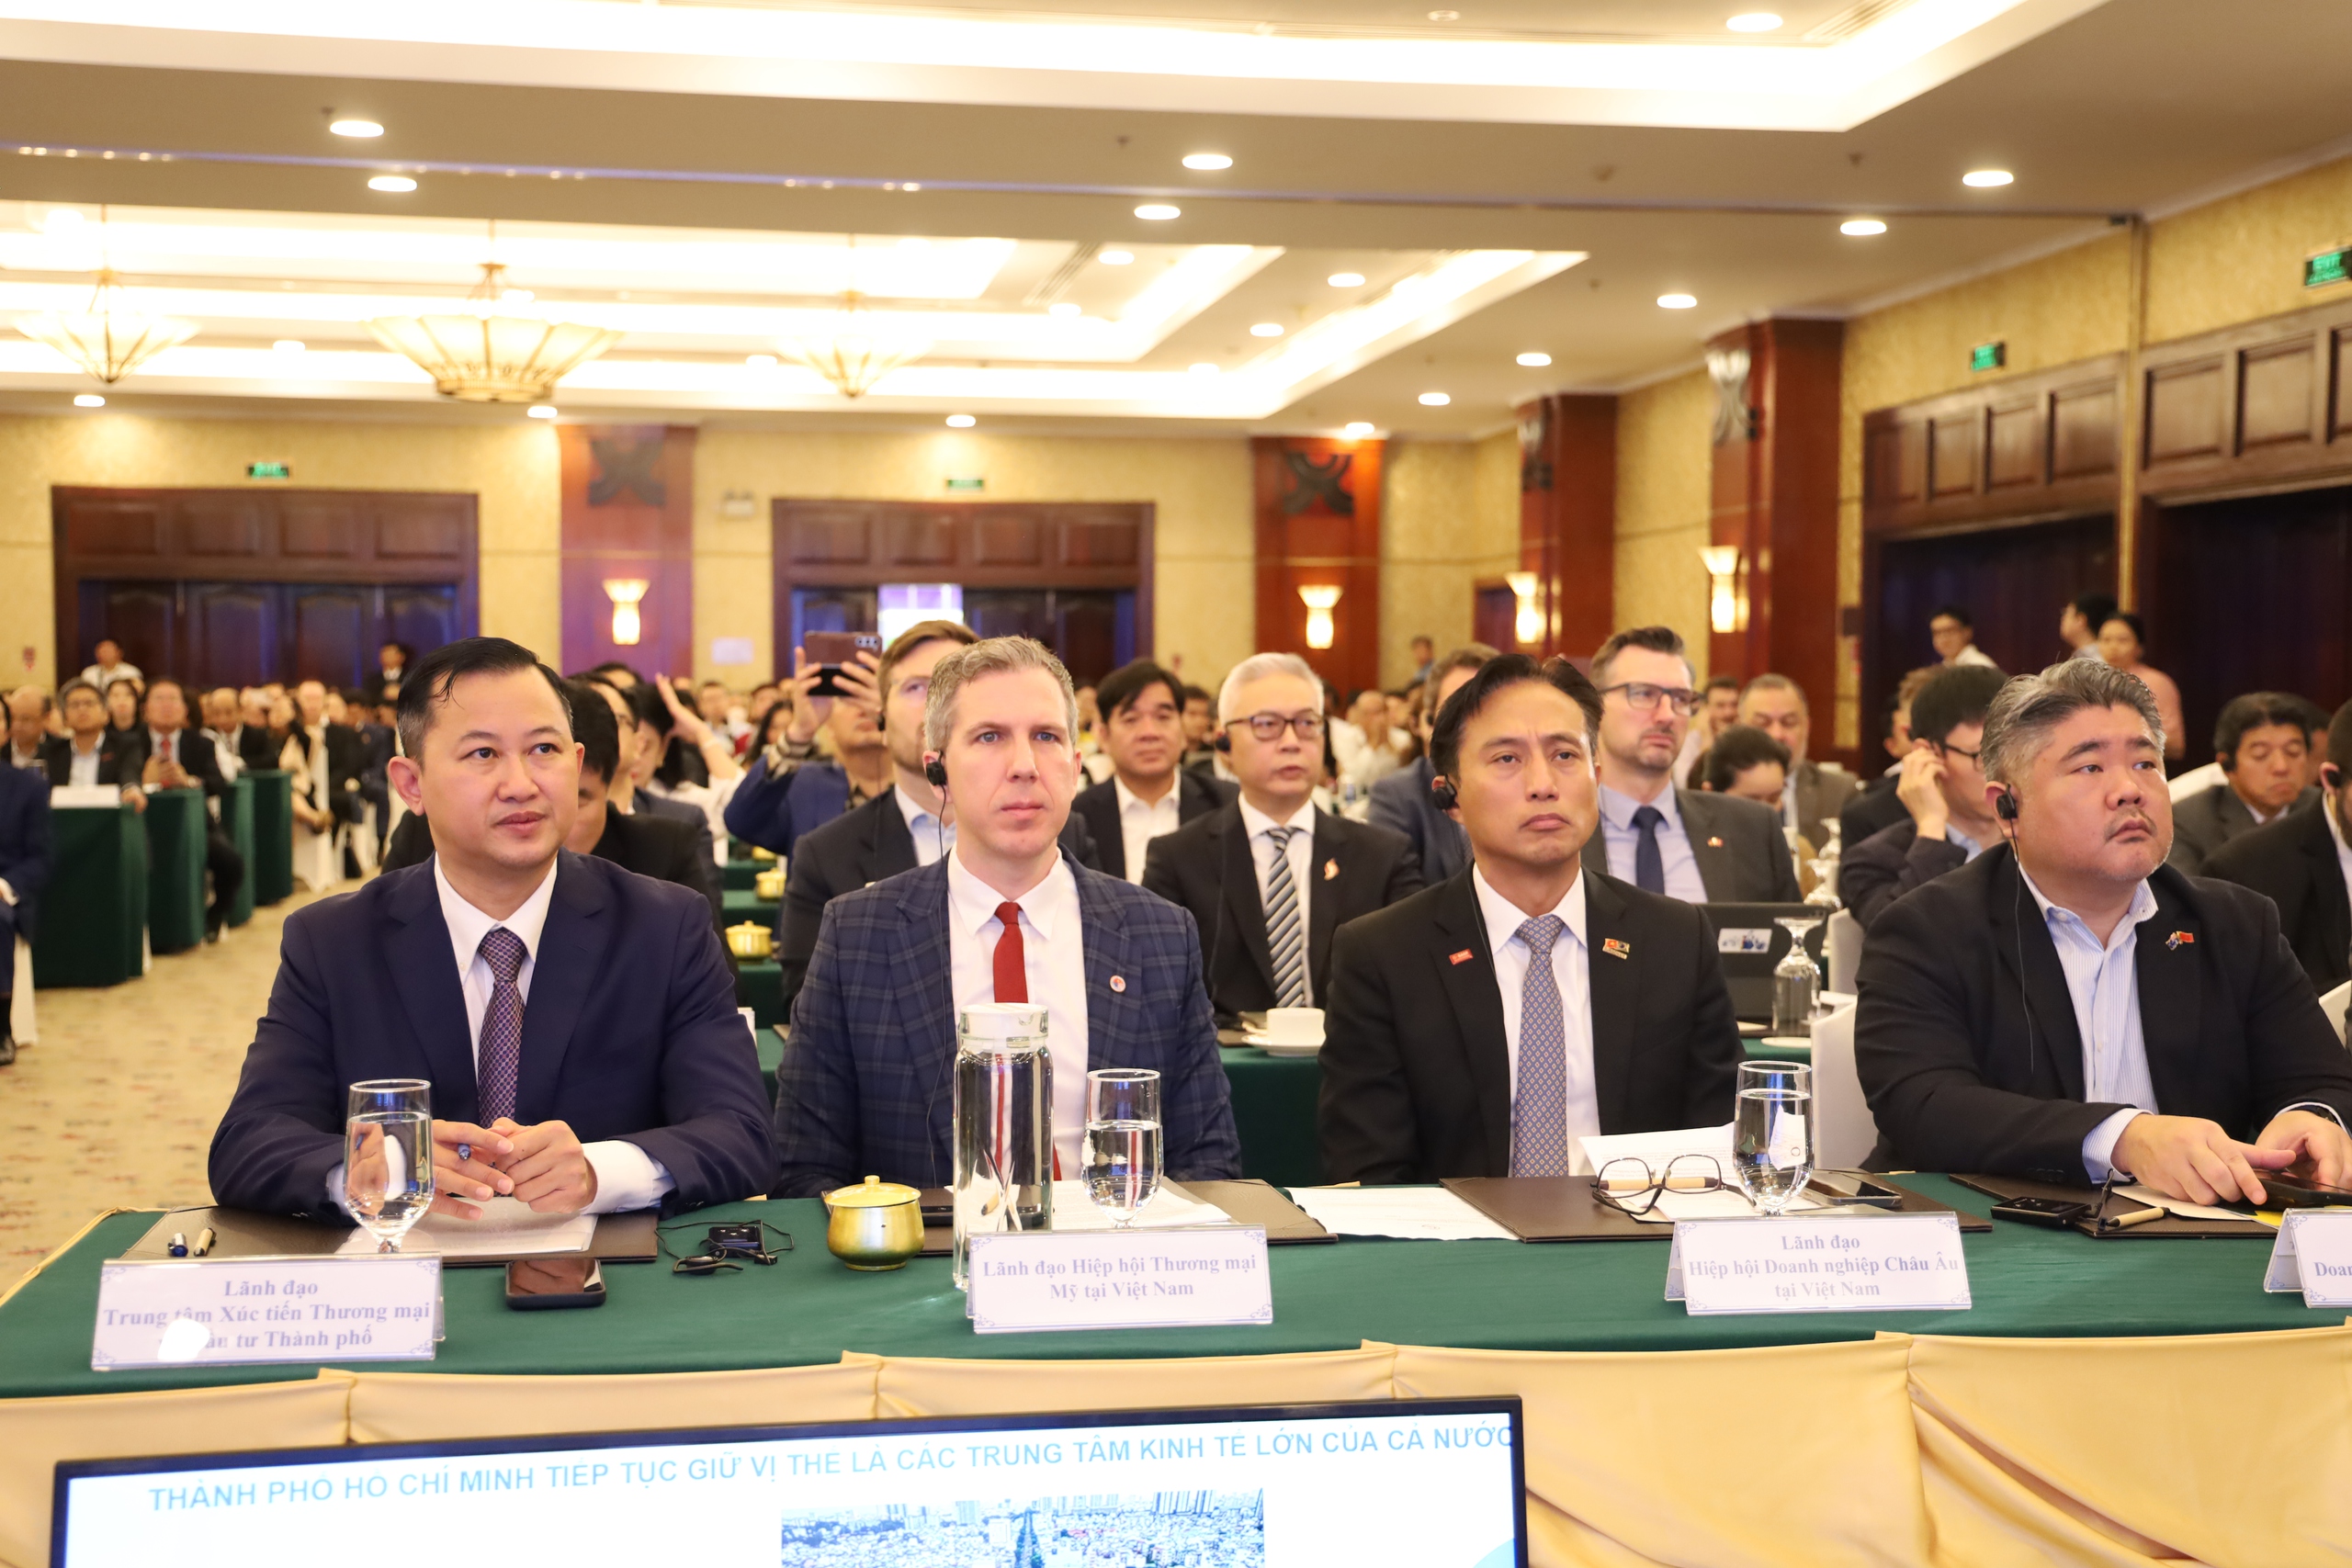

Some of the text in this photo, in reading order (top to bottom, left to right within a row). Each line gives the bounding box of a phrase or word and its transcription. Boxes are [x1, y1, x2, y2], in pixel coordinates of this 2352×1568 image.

[1781, 1235, 1860, 1253] Lãnh đạo
[983, 1254, 1257, 1279] Lãnh đạo Hiệp hội Thương mại
[1688, 1251, 1959, 1280] Hiệp hội Doanh nghiệp Châu Âu
[223, 1280, 319, 1299] Lãnh đạo
[1049, 1280, 1194, 1303] Mỹ tại Việt Nam
[1774, 1280, 1881, 1302] tại Việt Nam
[104, 1301, 430, 1328] Trung tâm Xúc tiến Thương mại
[236, 1334, 259, 1348] tư
[264, 1328, 328, 1348] Thành
[336, 1324, 373, 1349] phố
[148, 1479, 255, 1511] THÀNH
[399, 1464, 449, 1495] CHÍ
[459, 1468, 534, 1493] MINH
[620, 1461, 677, 1489] TỤC
[688, 1451, 741, 1480] GIỮ
[751, 1455, 775, 1483] VỊ
[852, 1444, 887, 1472] LÀ
[897, 1442, 956, 1470] CÁC
[967, 1443, 1062, 1467] TRUNG
[1072, 1435, 1130, 1462] TÂM
[1140, 1438, 1204, 1460] KINH
[1257, 1427, 1312, 1455] LỚN
[1322, 1425, 1378, 1452] CỦA
[1388, 1422, 1424, 1450] CẢ
[1433, 1420, 1512, 1449] NƯỚC
